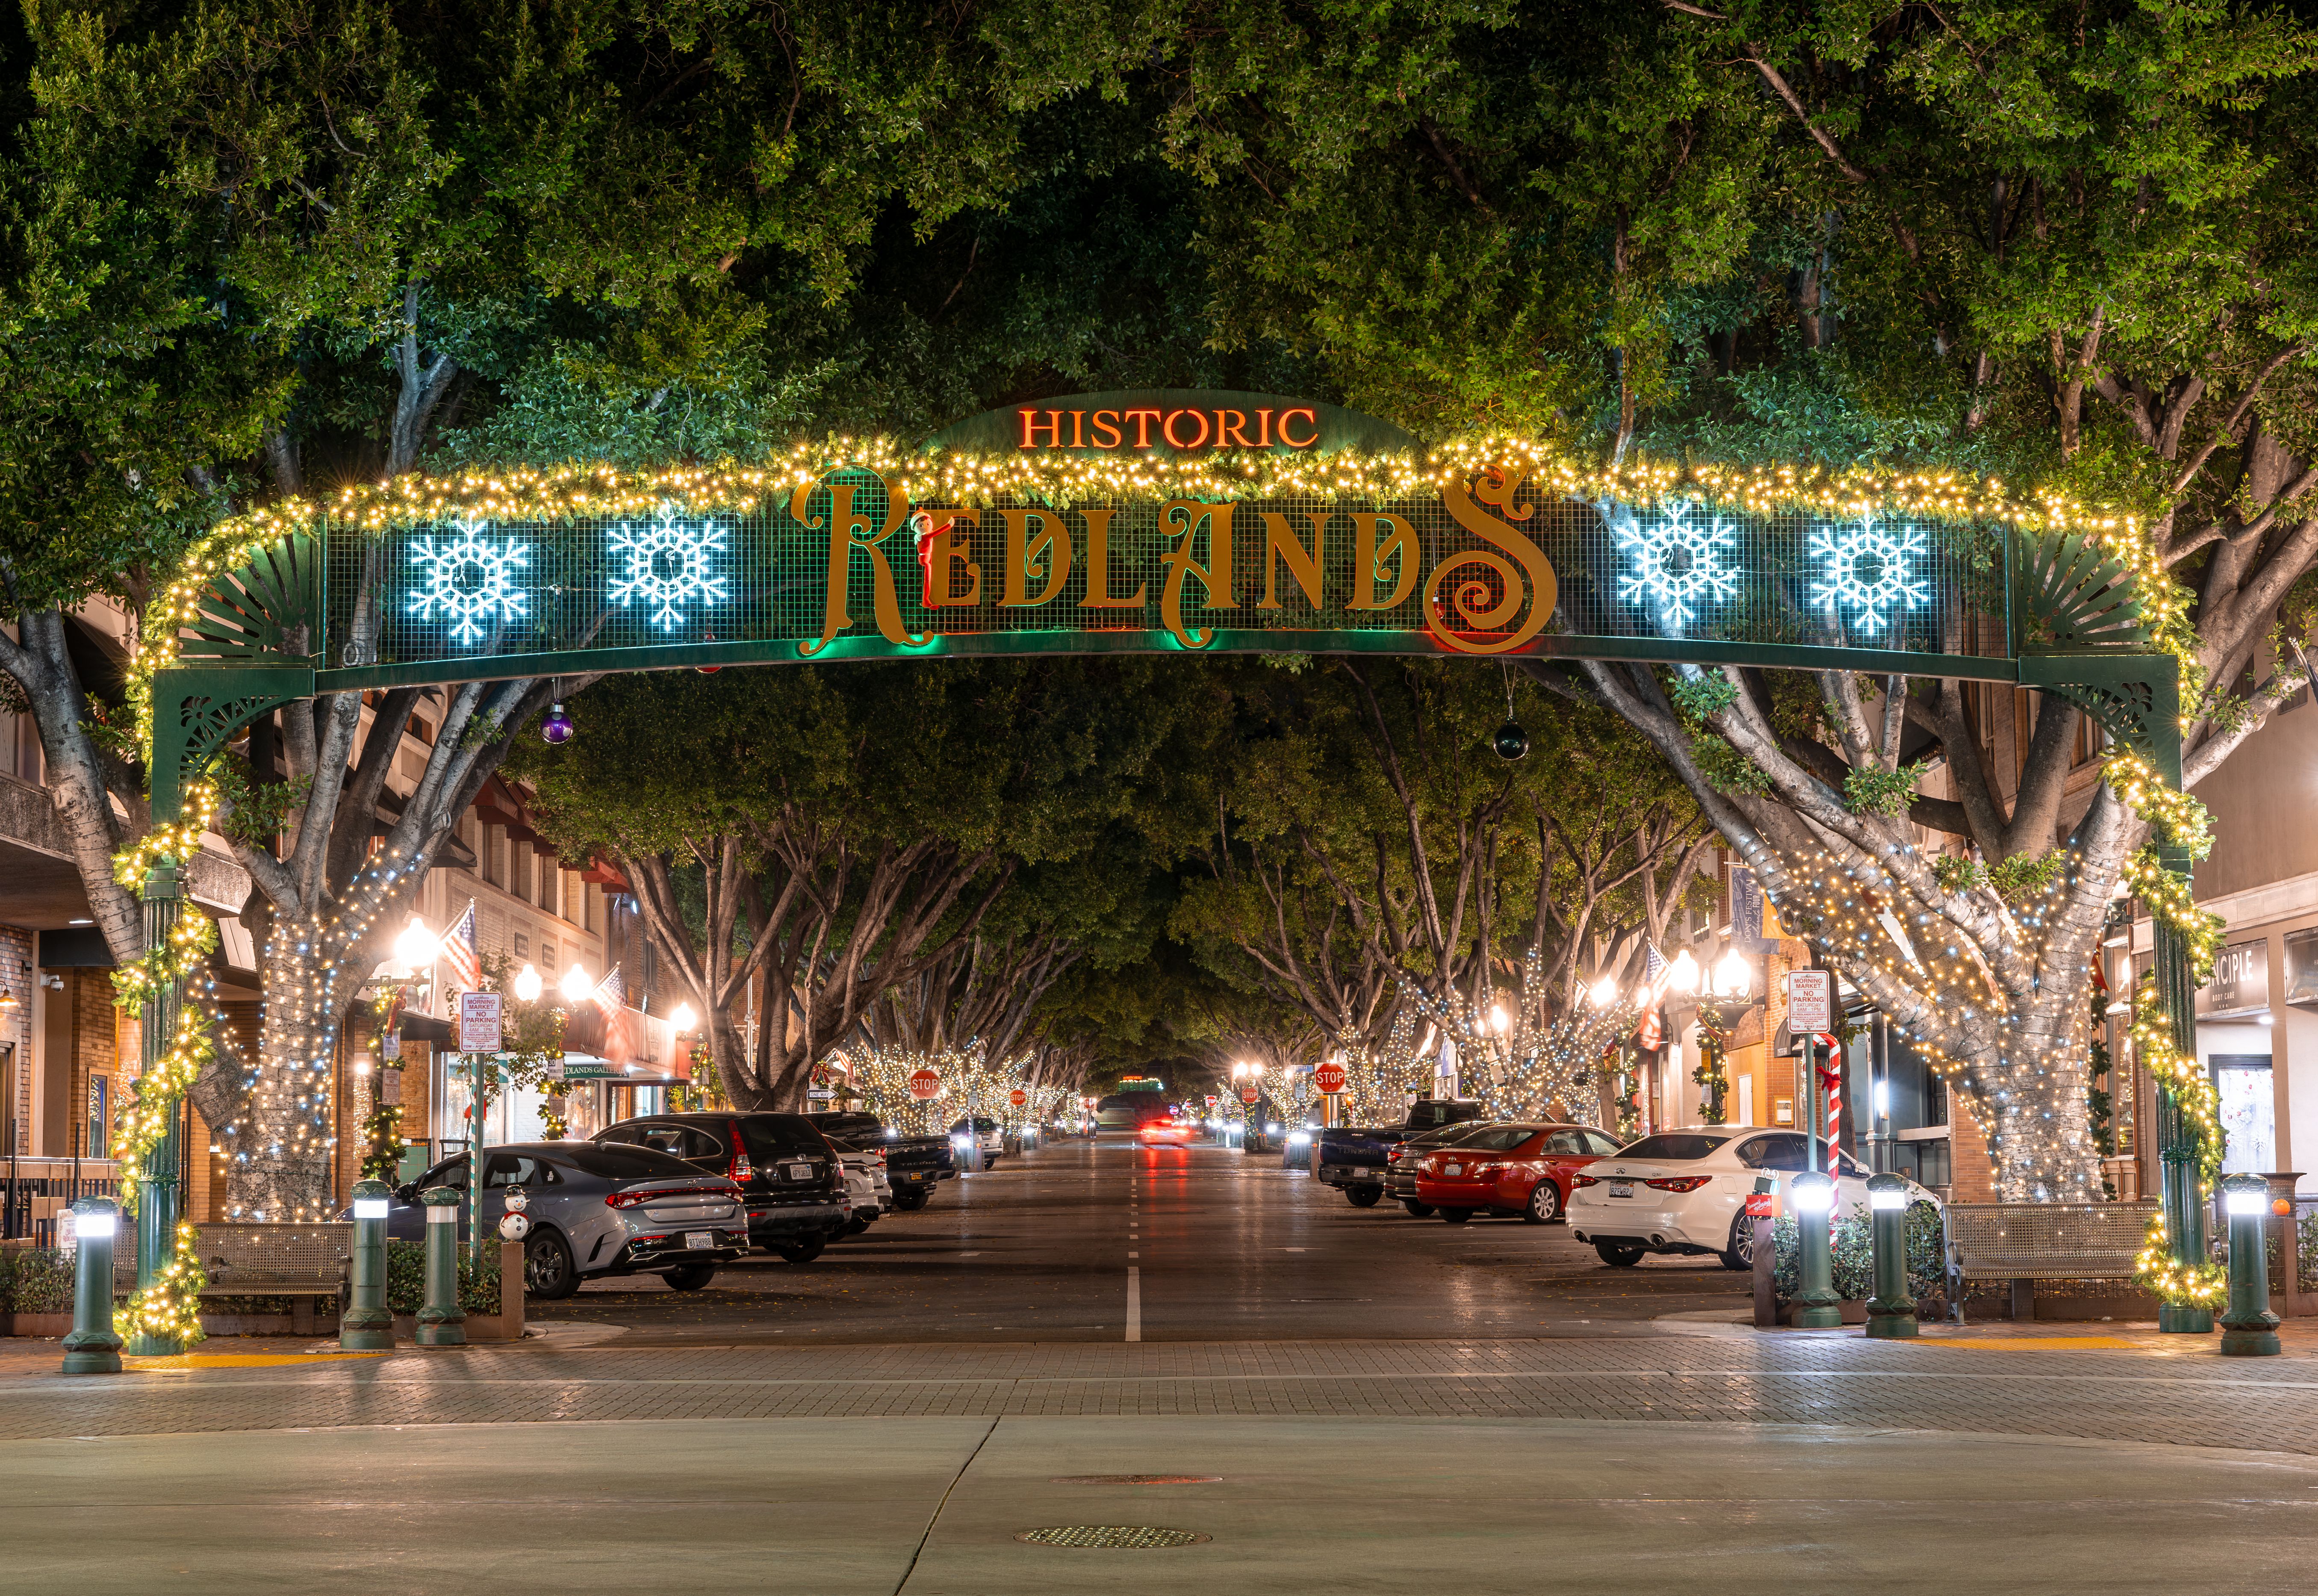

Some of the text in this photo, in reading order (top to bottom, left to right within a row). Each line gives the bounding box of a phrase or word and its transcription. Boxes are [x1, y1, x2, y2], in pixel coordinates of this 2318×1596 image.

[1018, 409, 1319, 448] HISTORIC
[791, 463, 1557, 655] REDLANDS
[2212, 991, 2235, 1002] BODY CARE
[563, 1066, 628, 1077] EDLANDS GALLERIA
[1317, 1072, 1344, 1083] STOP
[912, 1079, 938, 1090] STOP
[1337, 1147, 1379, 1155] TUNDRA
[793, 1169, 811, 1177] 6FYJ612
[688, 1238, 712, 1247] 8TIH988
